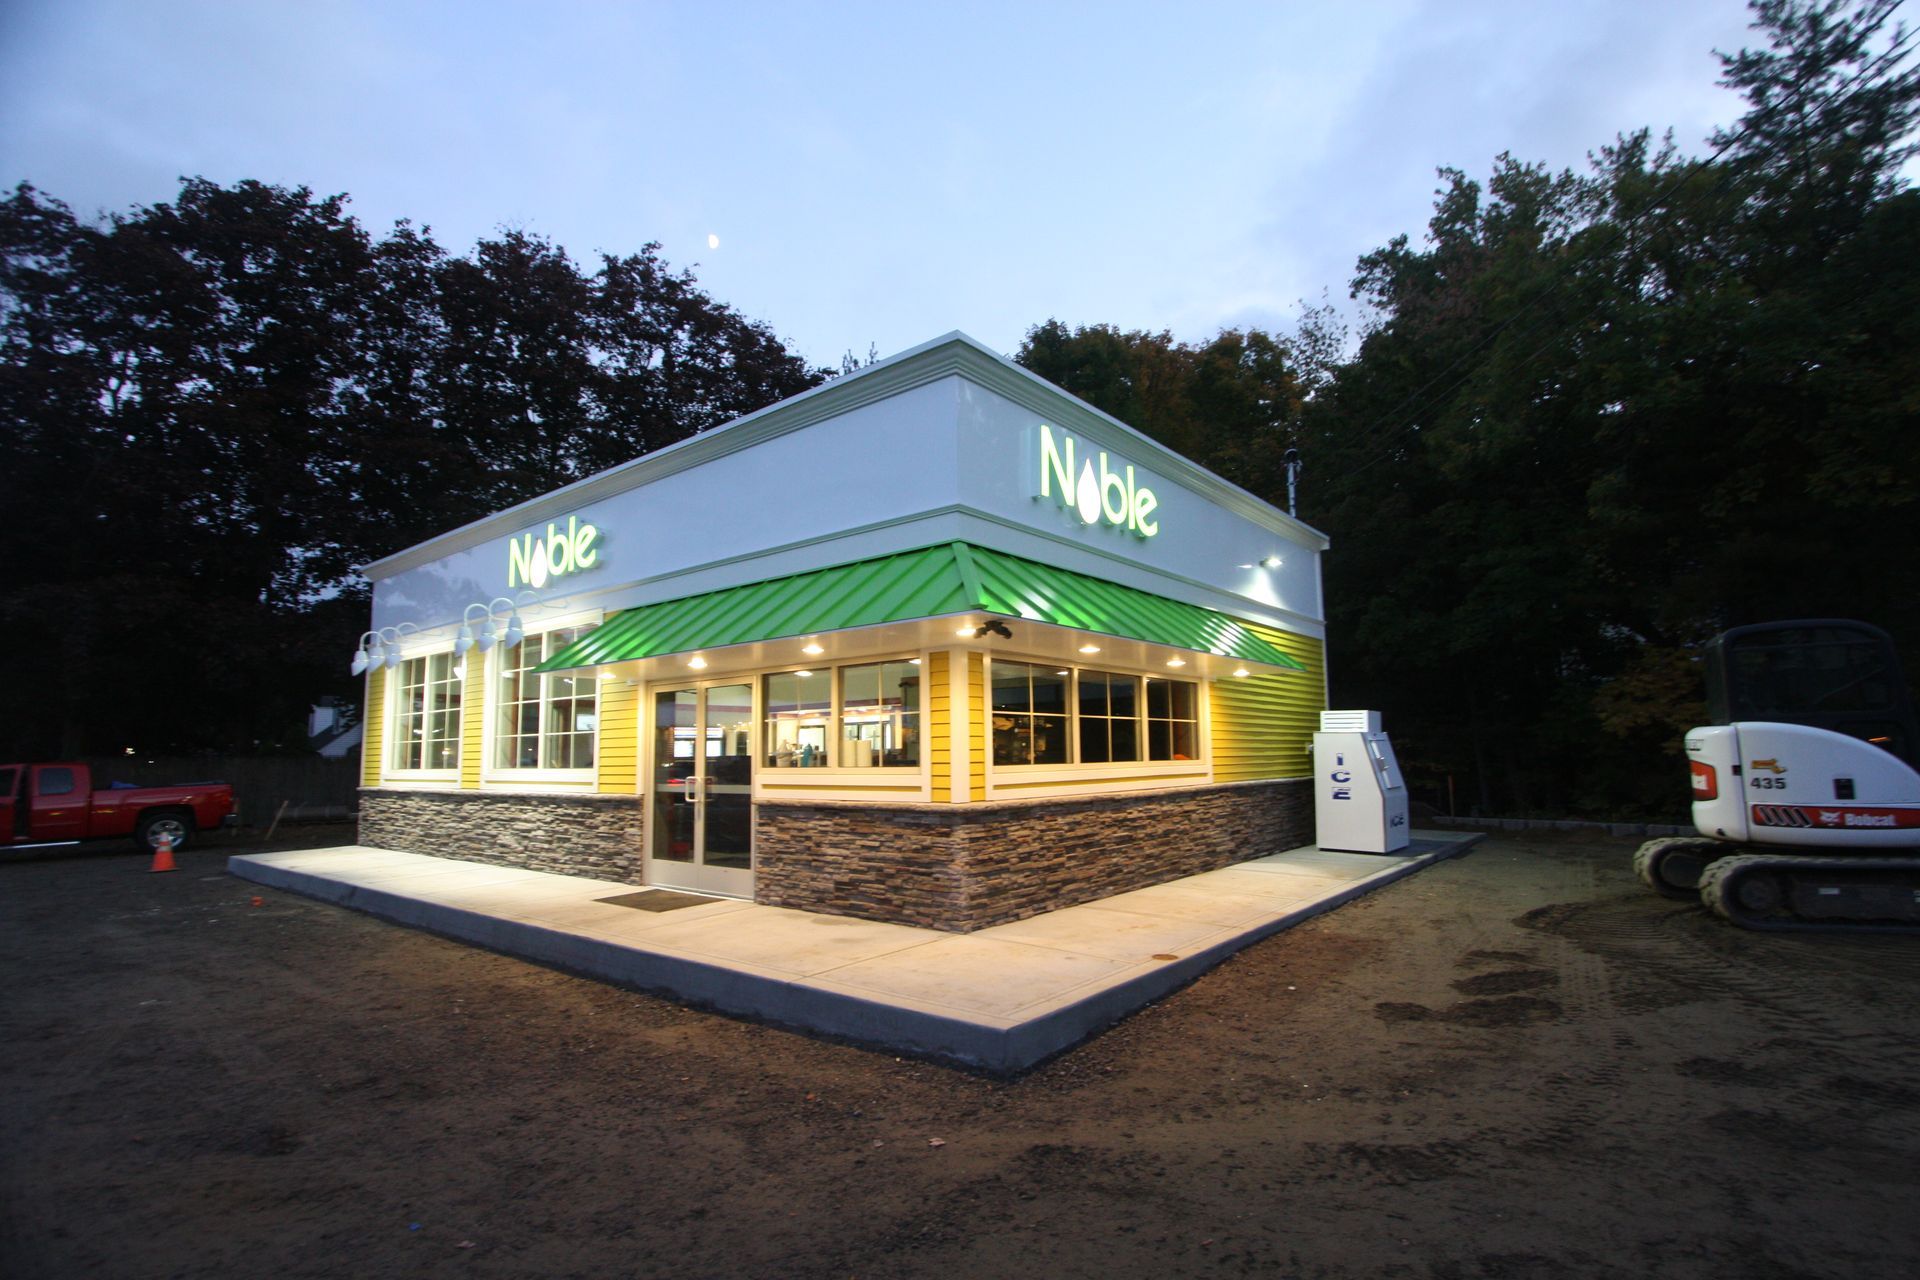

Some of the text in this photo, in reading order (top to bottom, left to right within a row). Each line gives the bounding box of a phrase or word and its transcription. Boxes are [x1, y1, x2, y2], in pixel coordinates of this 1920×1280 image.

[1040, 424, 1158, 537] Noble
[508, 515, 597, 588] Noble
[1331, 753, 1351, 800] ICE
[1750, 777, 1787, 790] 435
[1844, 813, 1897, 826] Bobcat
